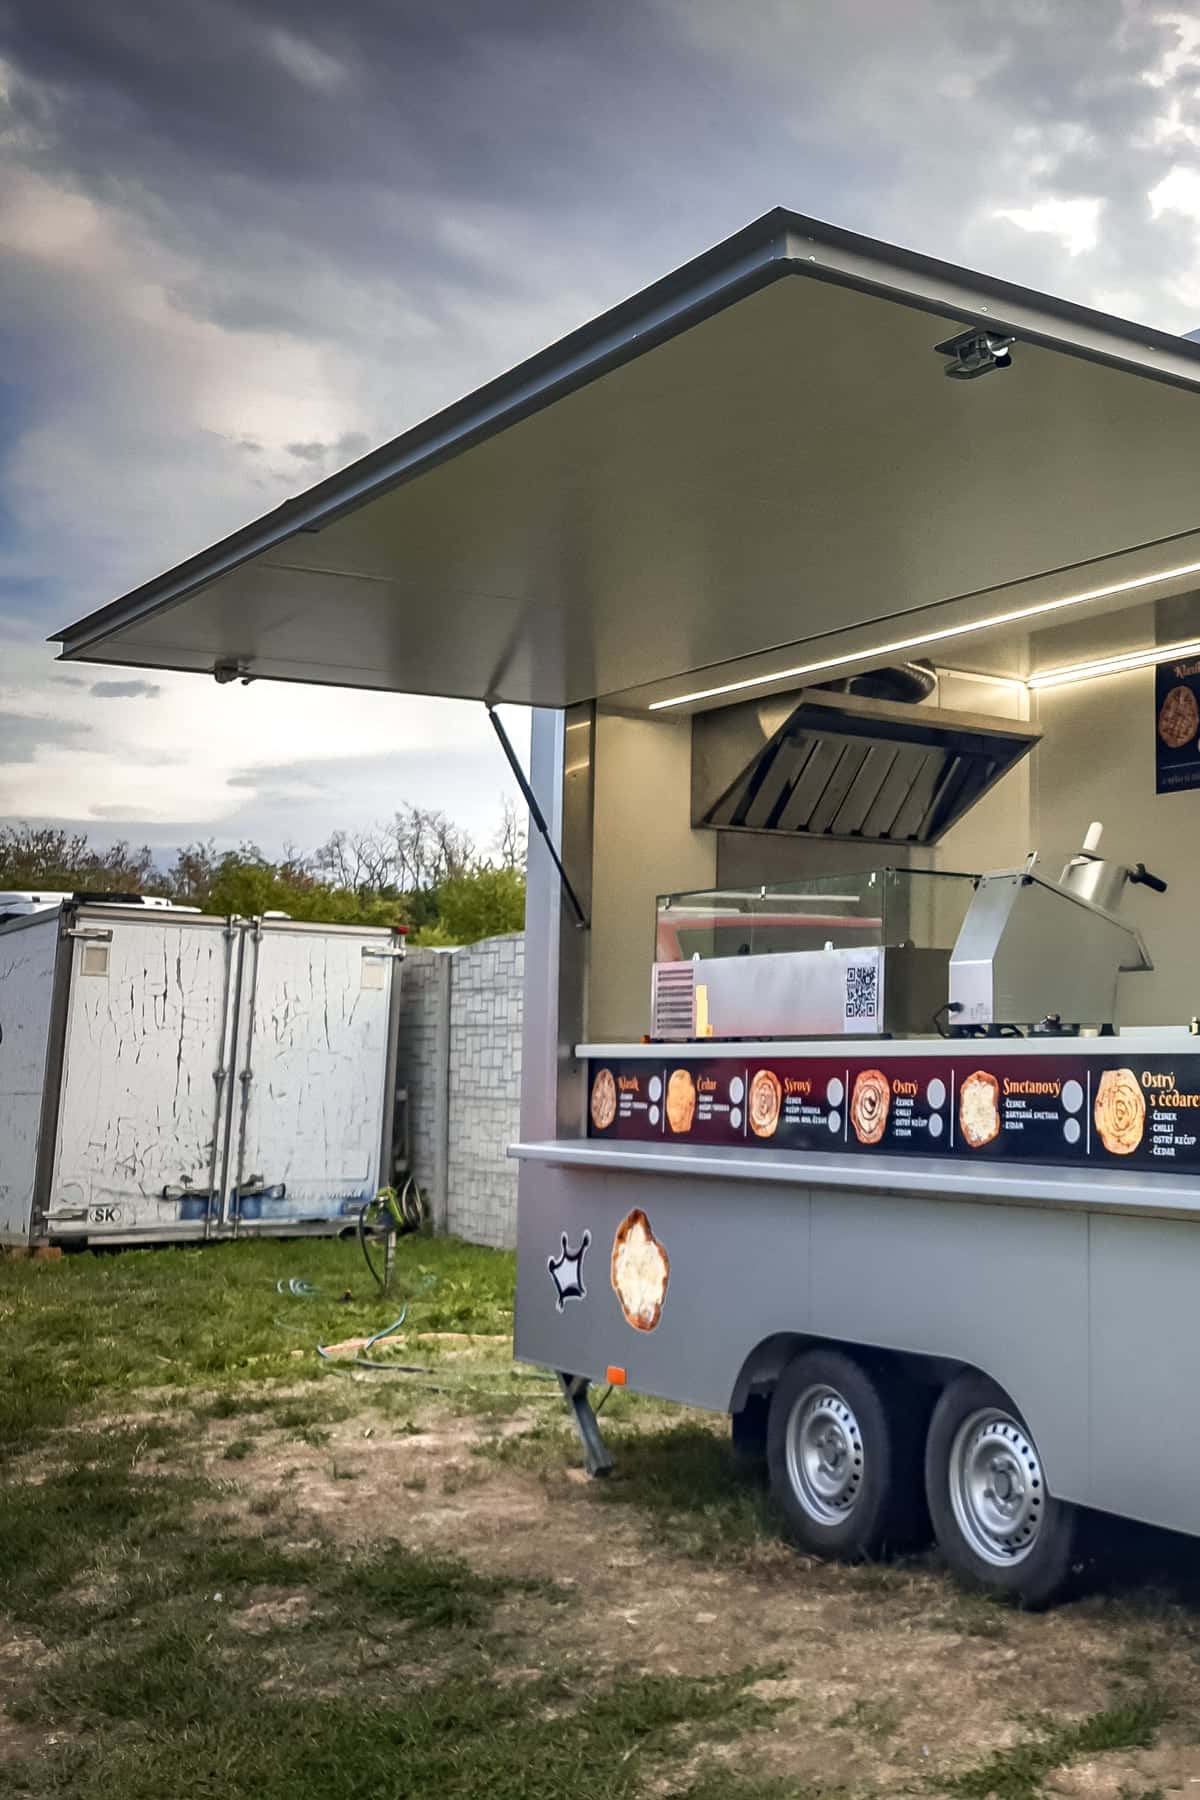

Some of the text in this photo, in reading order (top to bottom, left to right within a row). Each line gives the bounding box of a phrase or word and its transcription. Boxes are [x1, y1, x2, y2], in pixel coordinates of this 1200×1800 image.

[784, 1077, 812, 1095] Sýrový
[893, 1079, 919, 1097] Ostrý
[1003, 1078, 1060, 1098] Smetanový
[1141, 1071, 1176, 1092] Ostrý
[1150, 1094, 1156, 1106] s
[95, 1207, 115, 1222] SK
